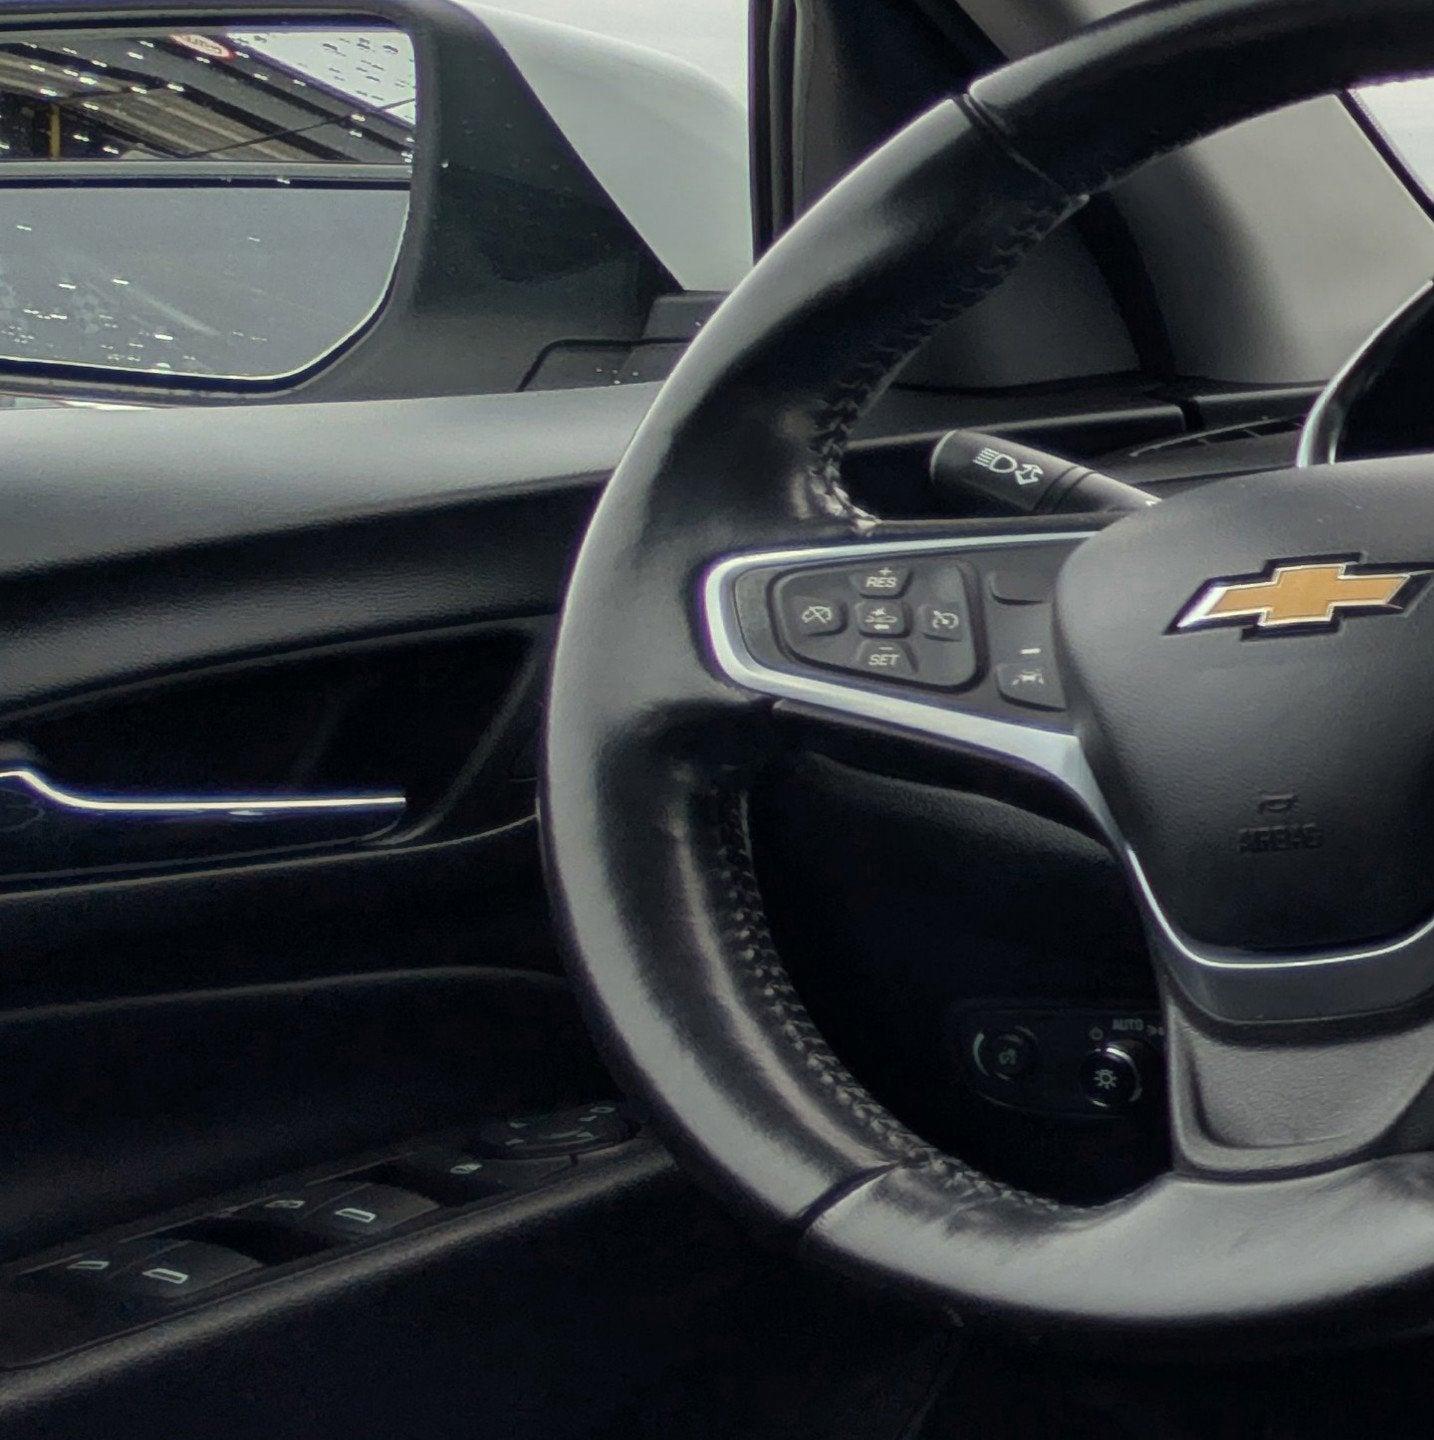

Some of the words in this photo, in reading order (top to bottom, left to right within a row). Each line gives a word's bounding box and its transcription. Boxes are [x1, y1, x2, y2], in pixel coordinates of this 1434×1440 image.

[865, 576, 897, 588] RES
[869, 653, 899, 667] SET
[1112, 1017, 1145, 1031] AUTO
